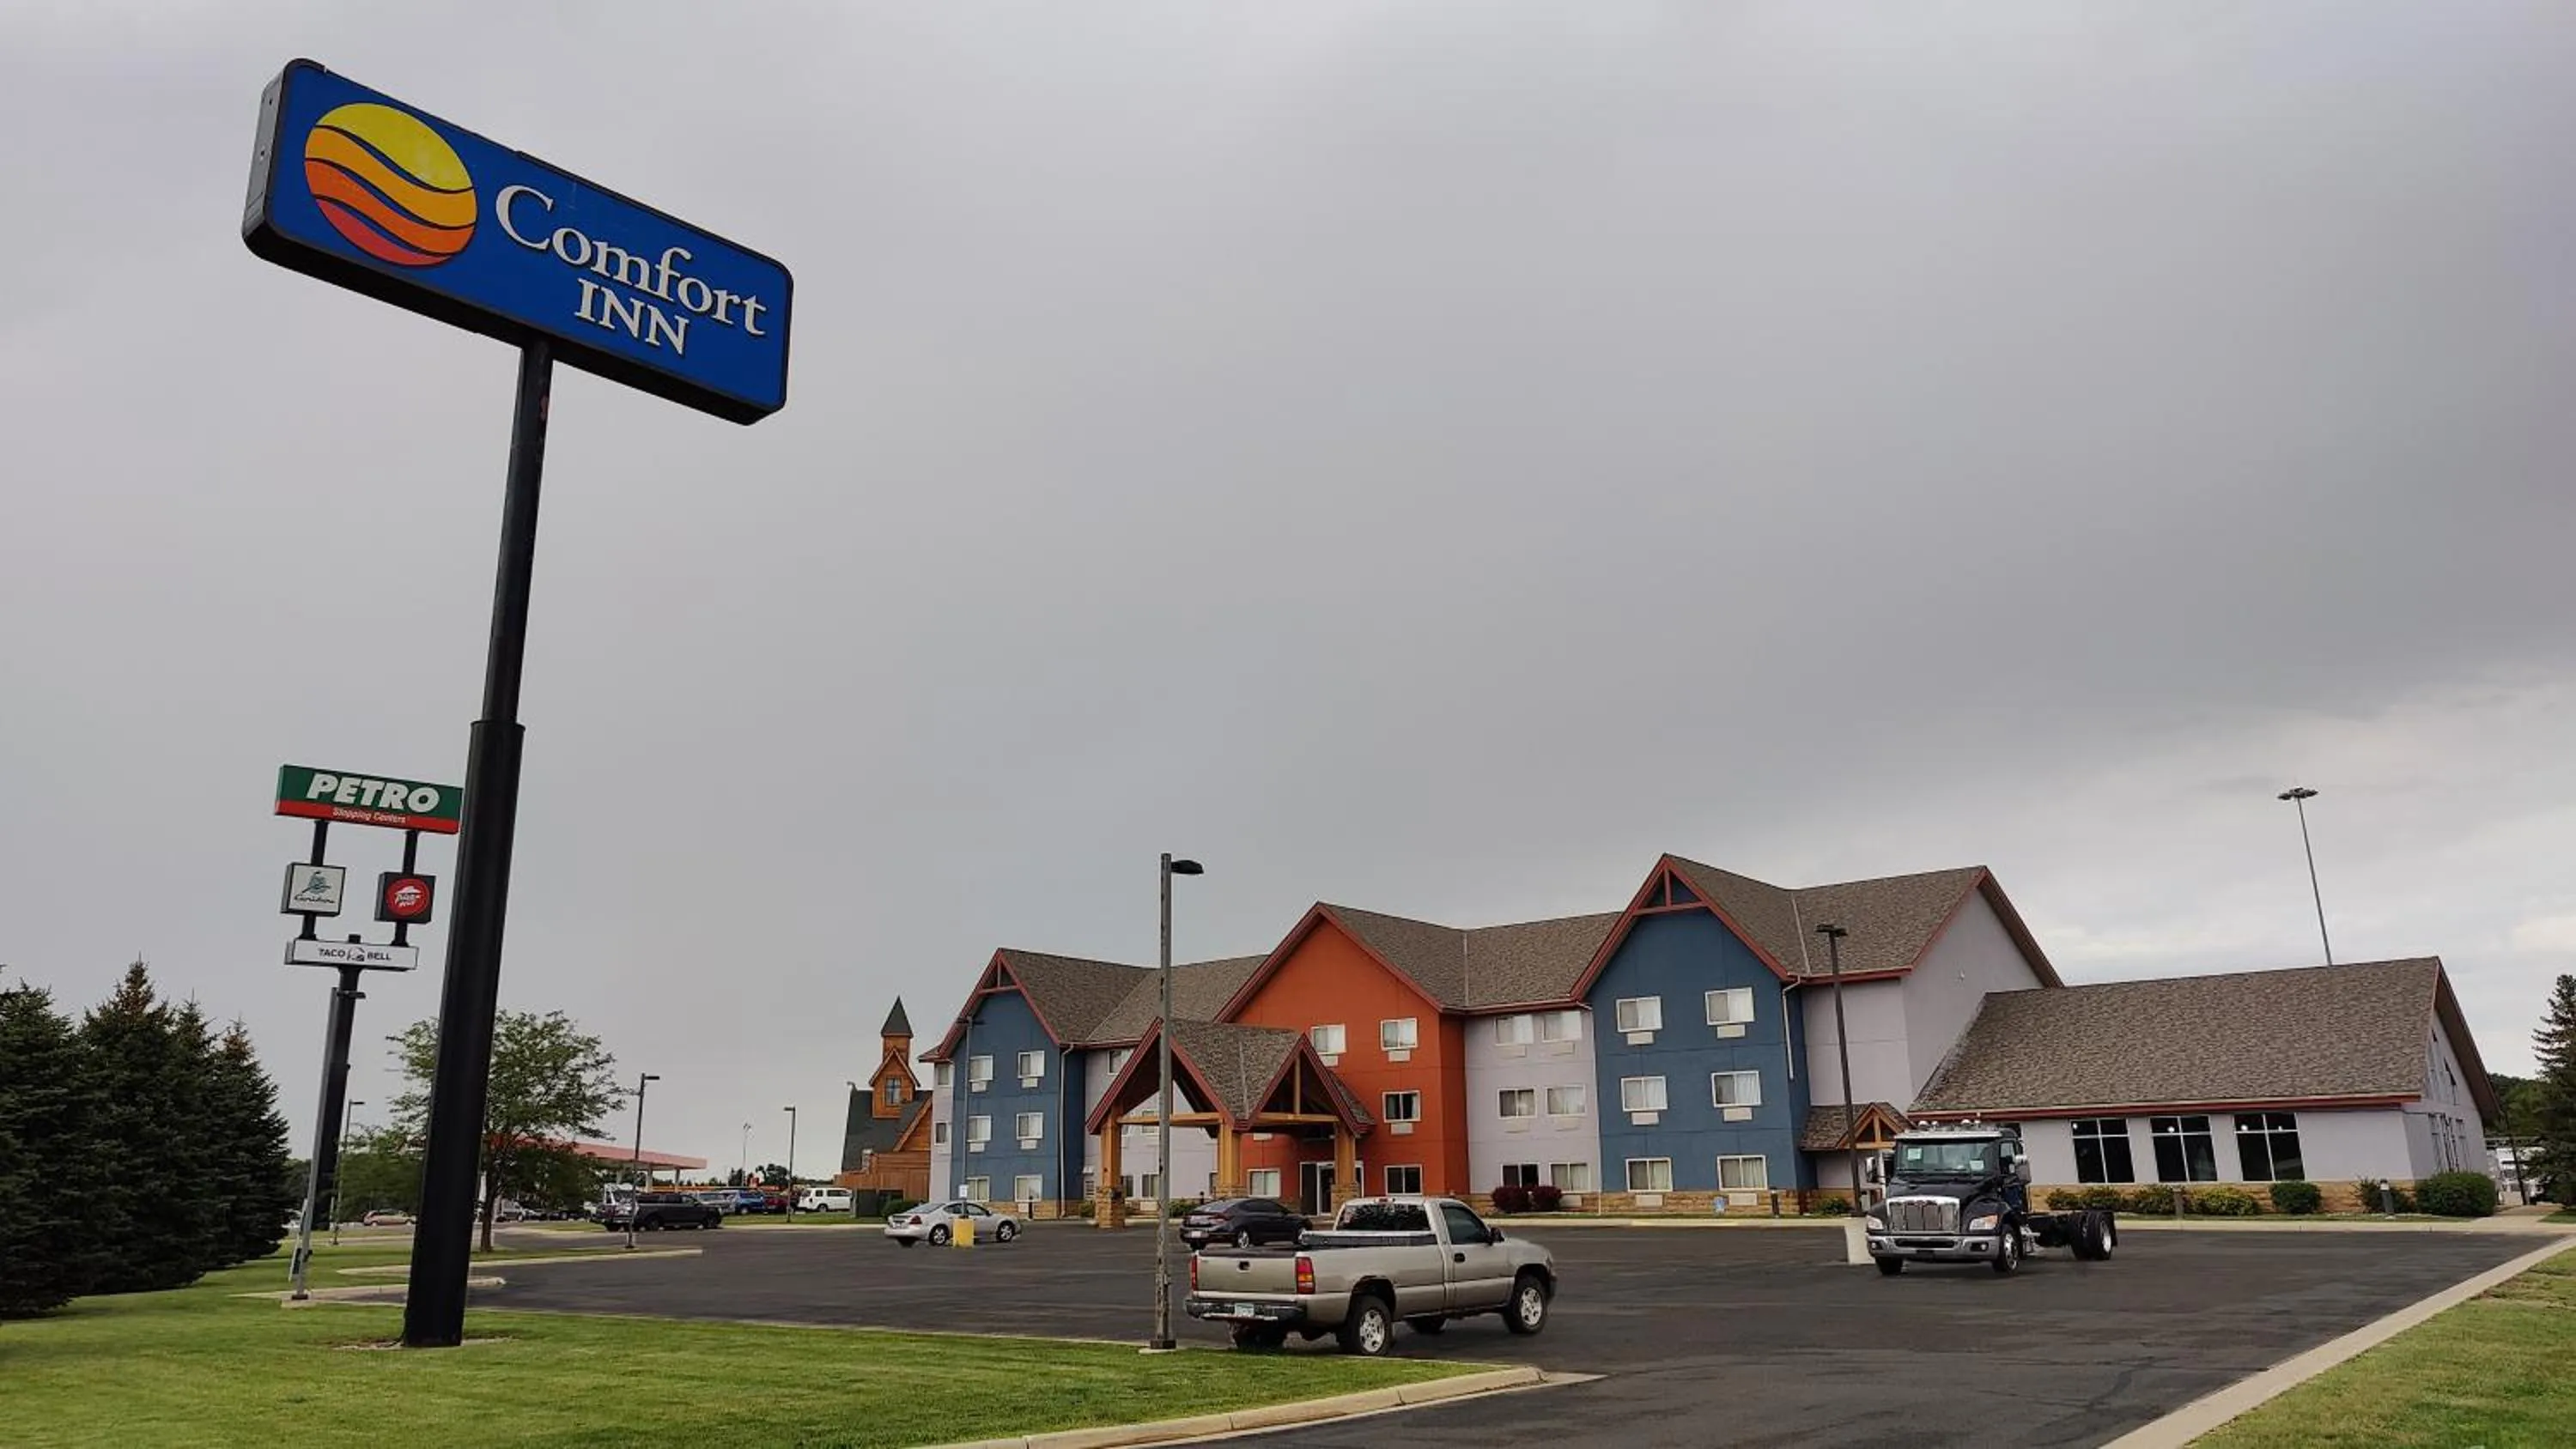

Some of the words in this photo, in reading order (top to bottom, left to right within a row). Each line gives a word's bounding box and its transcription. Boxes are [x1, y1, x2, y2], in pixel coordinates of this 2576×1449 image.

[495, 185, 767, 336] Comfort
[574, 278, 690, 355] INN
[307, 773, 440, 813] PETRO
[318, 948, 346, 958] TACO
[367, 951, 392, 961] BELL
